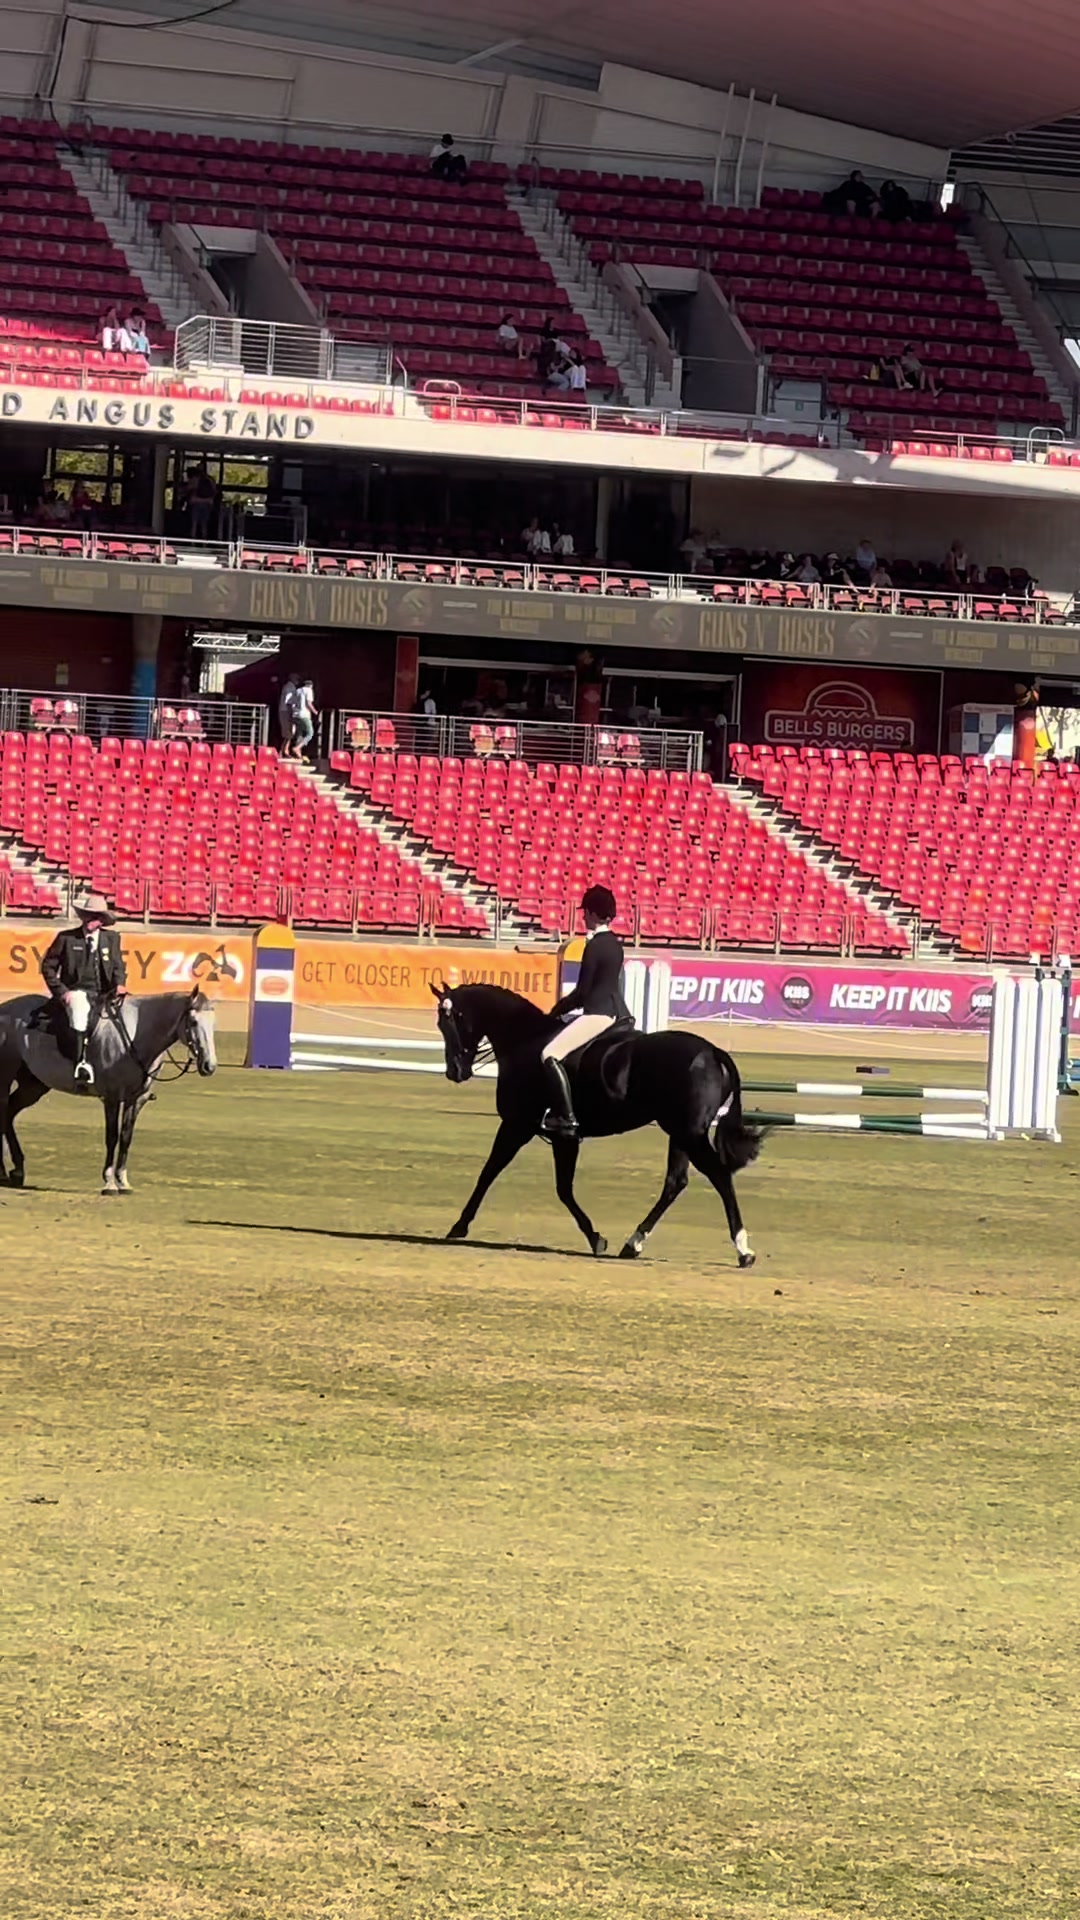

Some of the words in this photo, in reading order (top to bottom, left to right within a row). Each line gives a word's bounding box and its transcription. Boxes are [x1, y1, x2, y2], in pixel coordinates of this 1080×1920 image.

[49, 396, 175, 429] ANGUS
[200, 407, 315, 439] STAND
[249, 579, 300, 620] GUNS
[329, 584, 389, 627] ROSES
[699, 610, 748, 650] GUNS
[777, 614, 836, 656] ROSES
[774, 719, 823, 736] BELLS
[827, 721, 905, 741] BURGERS
[8, 944, 157, 980] SYY
[302, 961, 336, 983] GET
[344, 963, 411, 988] CLOSER
[420, 967, 444, 986] TO
[671, 976, 699, 1001] EP
[699, 977, 722, 1002] IT
[721, 978, 765, 1004] KIIS
[829, 983, 886, 1010] KEEP
[886, 986, 909, 1012] IT
[909, 988, 952, 1013] KIIS
